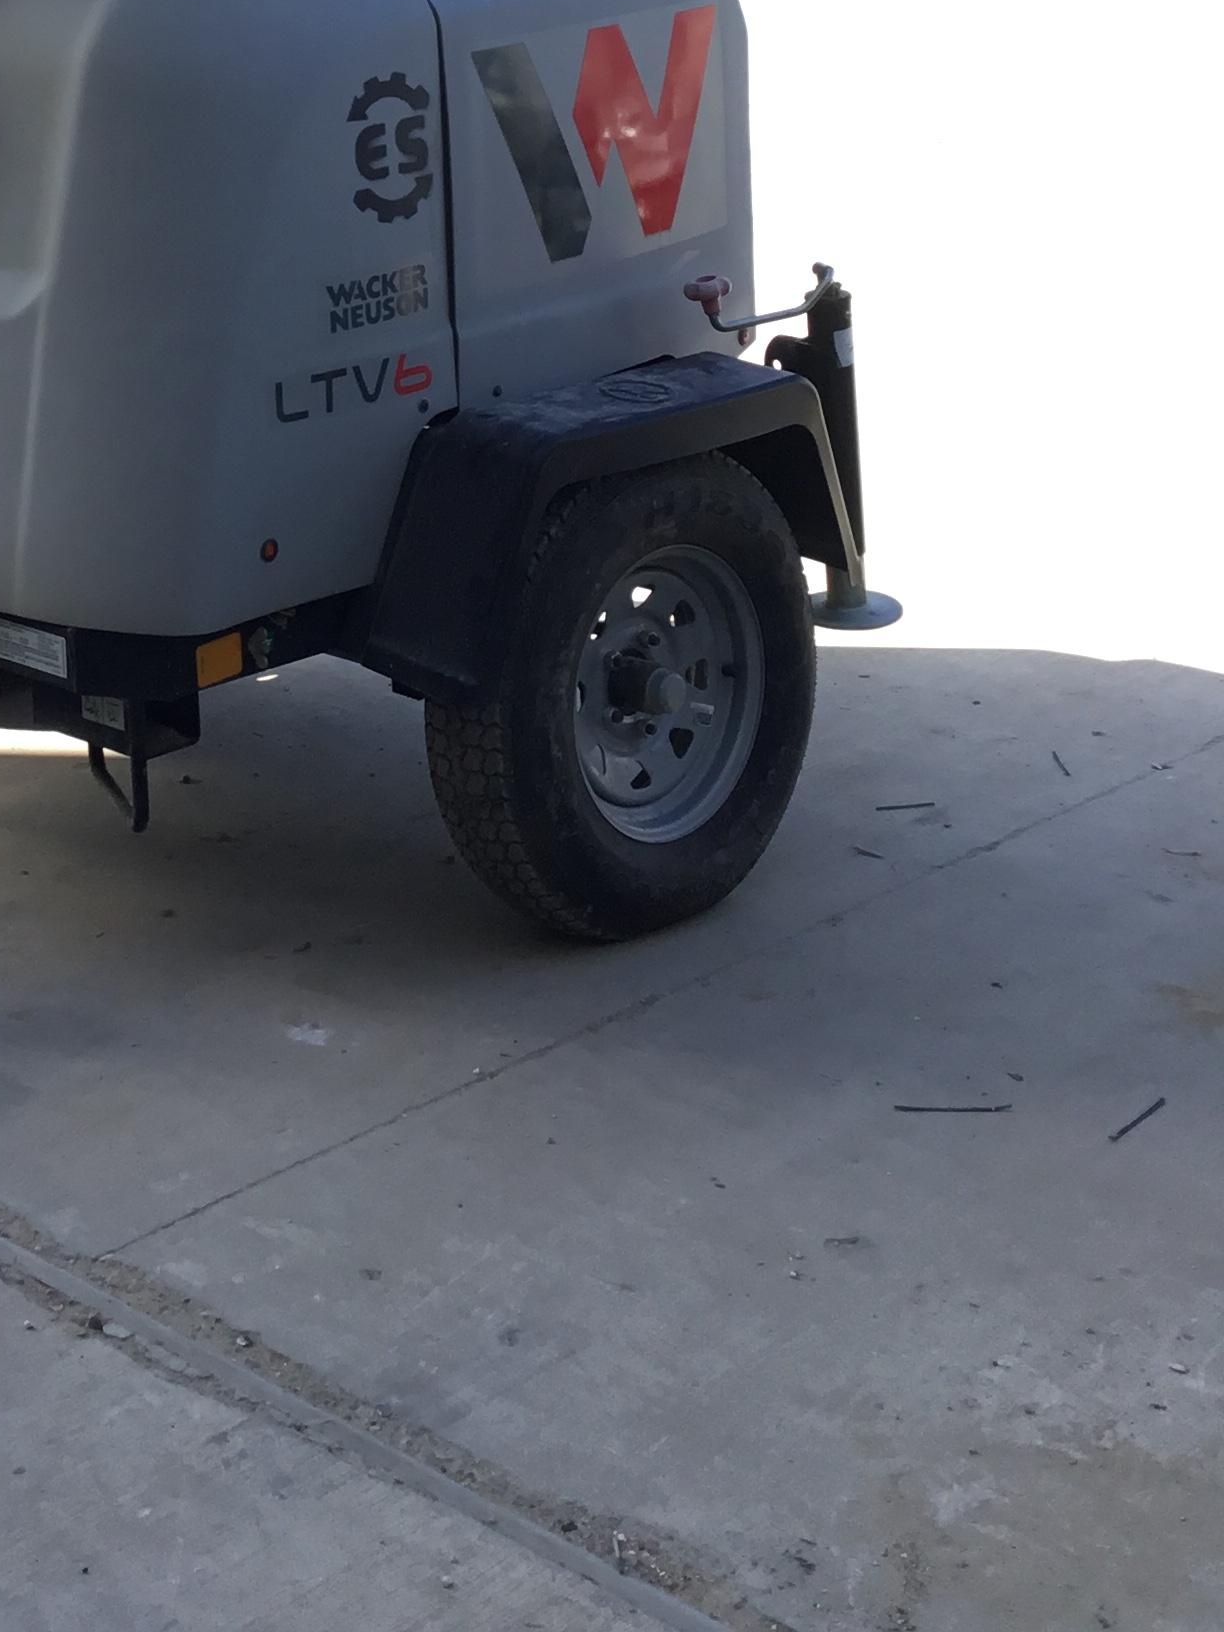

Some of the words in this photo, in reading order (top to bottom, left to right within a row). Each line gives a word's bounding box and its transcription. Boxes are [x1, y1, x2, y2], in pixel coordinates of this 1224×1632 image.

[355, 115, 429, 181] ES
[471, 5, 716, 263] W
[326, 264, 428, 307] WACKER
[329, 287, 429, 334] NEUSON
[276, 352, 432, 423] LTV6
